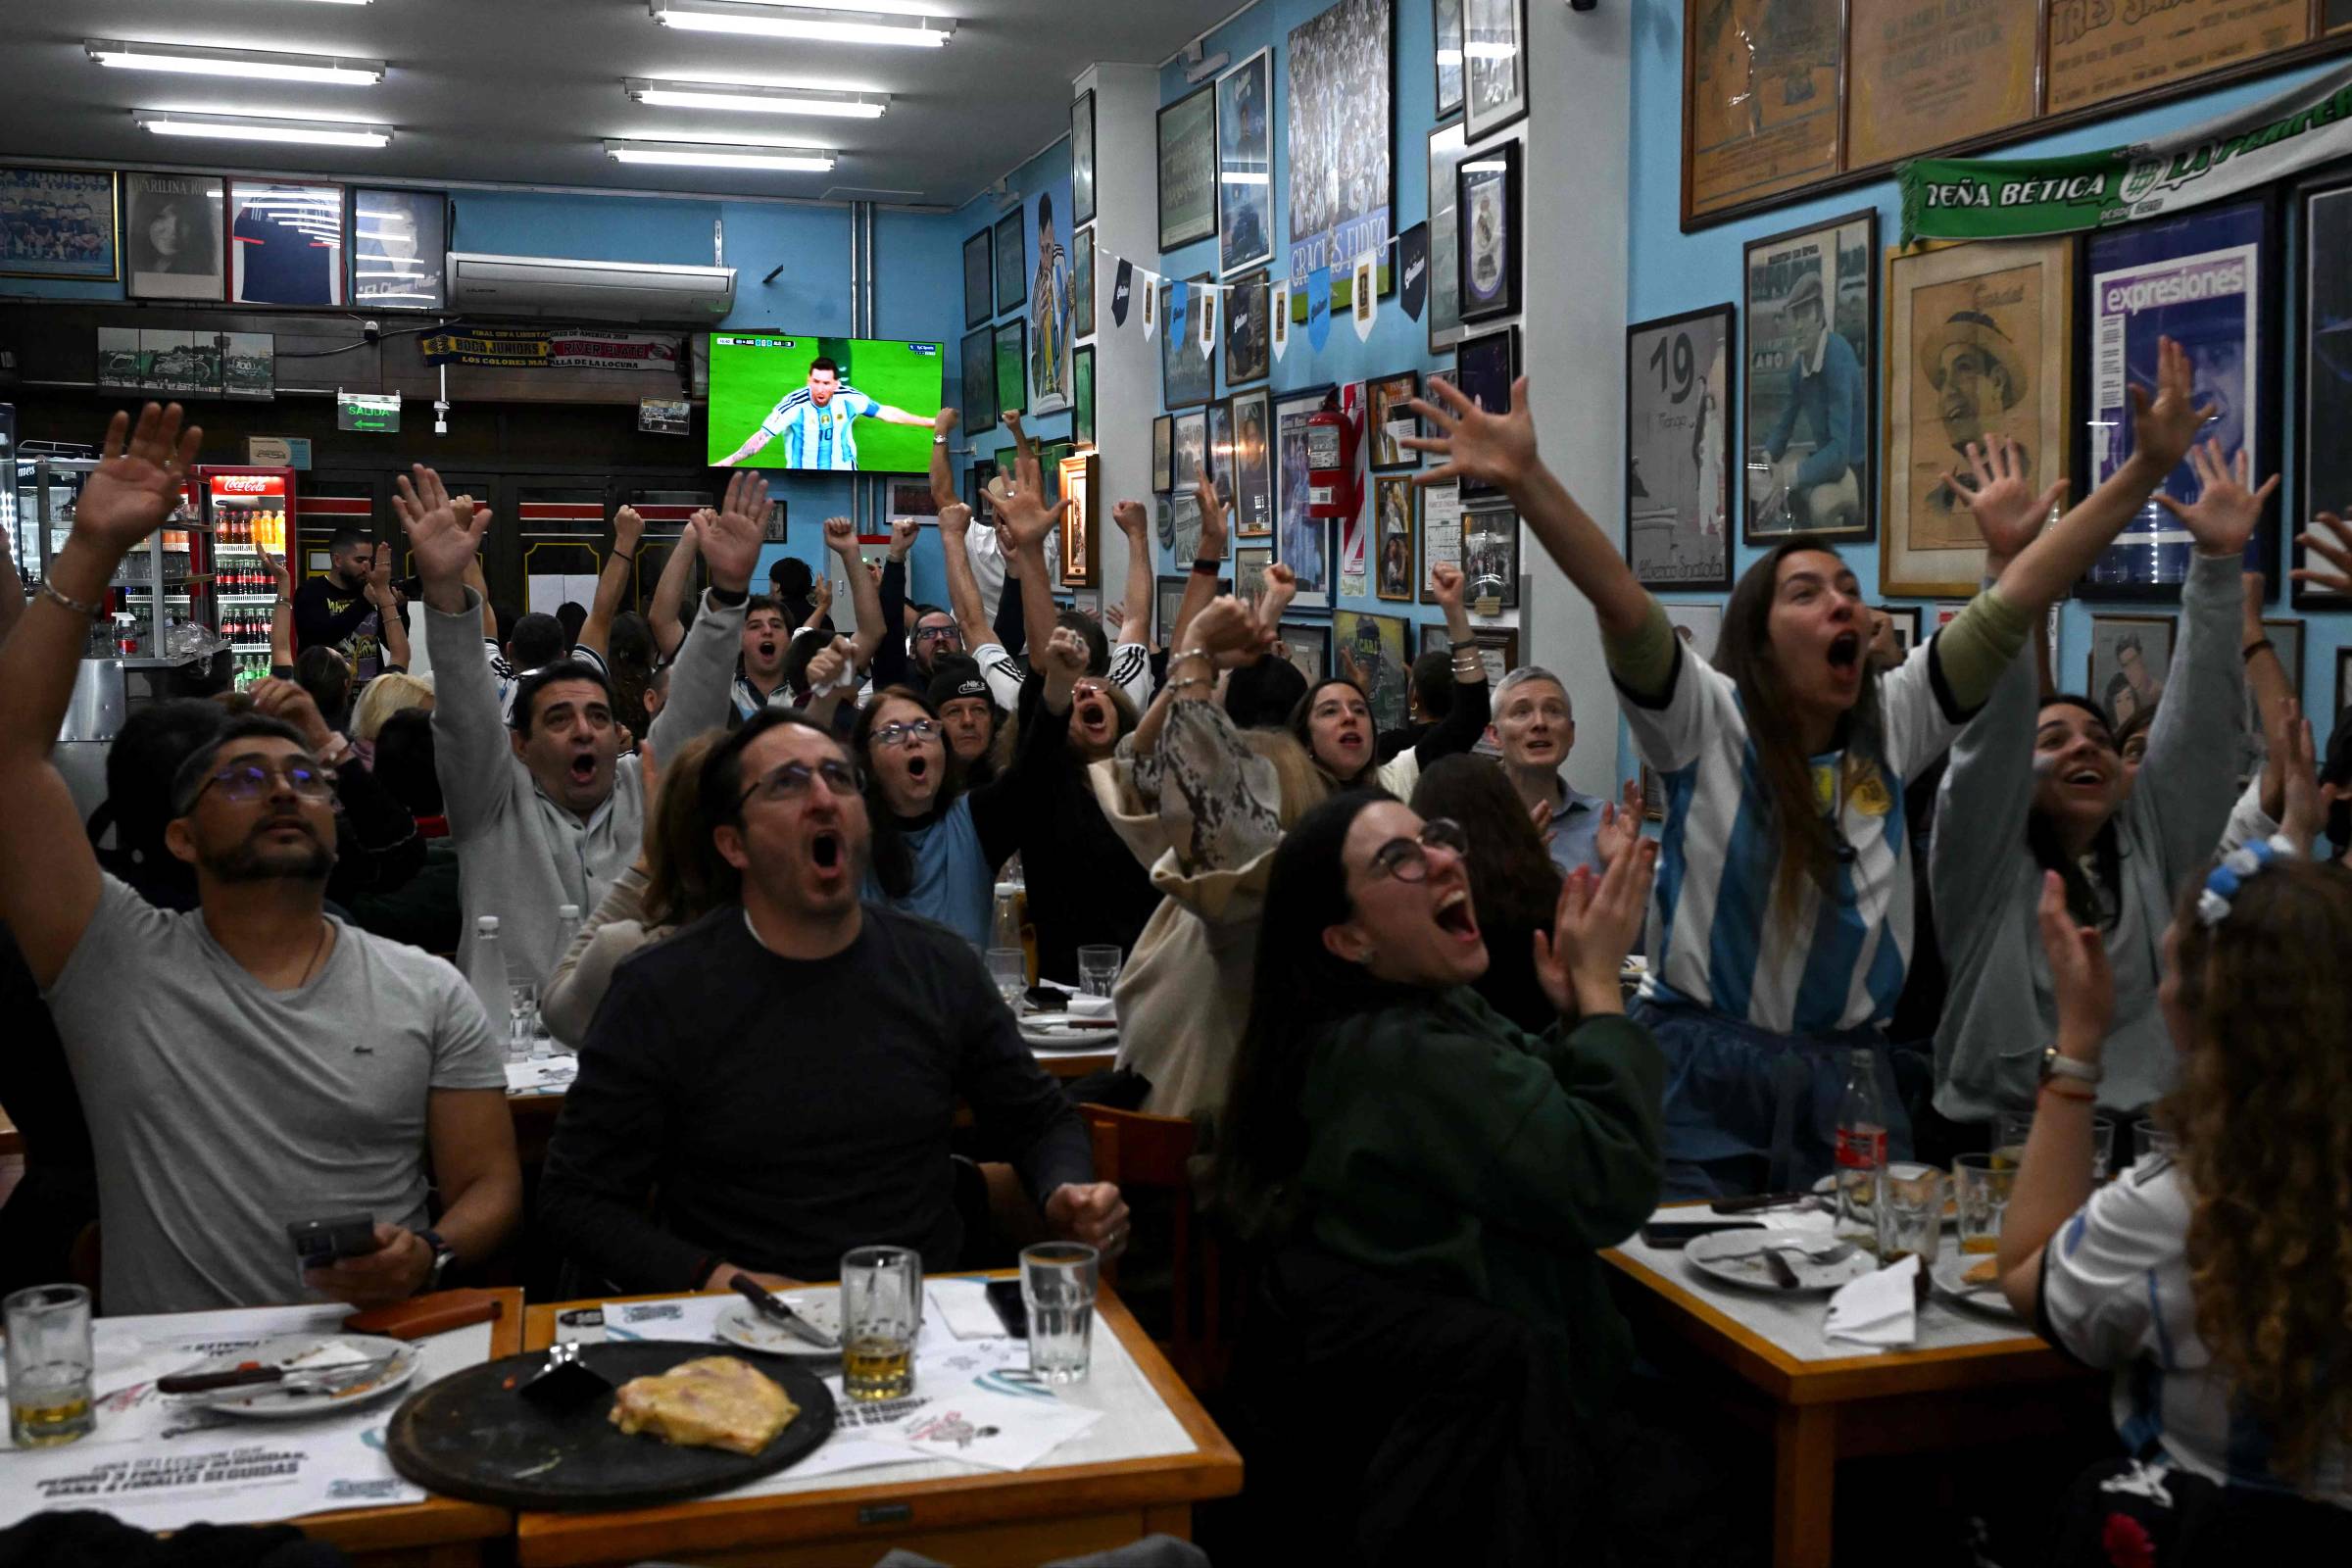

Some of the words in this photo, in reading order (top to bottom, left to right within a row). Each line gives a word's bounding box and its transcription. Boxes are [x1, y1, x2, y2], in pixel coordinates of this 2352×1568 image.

[24, 171, 108, 185] JUNIORS
[2000, 174, 2105, 206] BÉTICA
[2108, 266, 2243, 316] expresiones
[456, 338, 487, 353] BOCA
[488, 341, 539, 356] JUNIORS
[564, 342, 601, 354] RIVER
[607, 345, 644, 357] PLATE
[1648, 331, 1694, 405] 19
[348, 406, 390, 416] SALIDA
[819, 428, 834, 441] 10
[202, 1461, 299, 1483] SEGUIDAS
